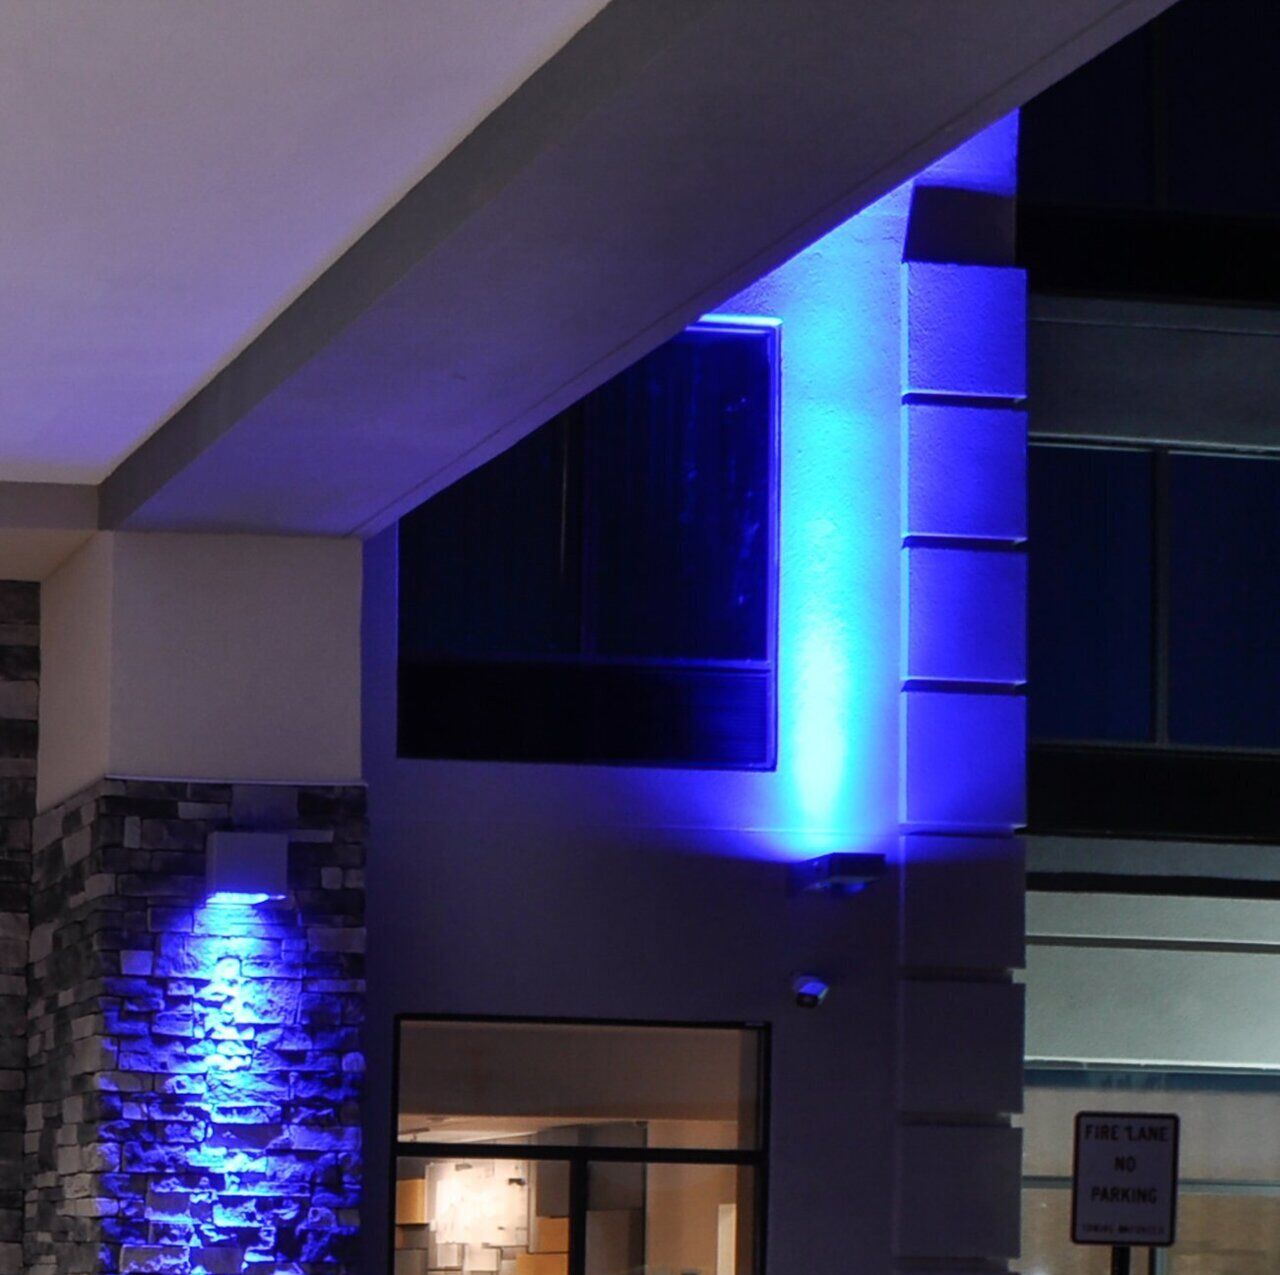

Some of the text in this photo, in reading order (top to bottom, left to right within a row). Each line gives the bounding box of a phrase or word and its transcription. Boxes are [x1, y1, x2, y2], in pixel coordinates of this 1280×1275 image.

[1085, 1125, 1169, 1142] FIRE LANE
[1114, 1156, 1137, 1172] NO
[1091, 1186, 1158, 1204] PARKING
